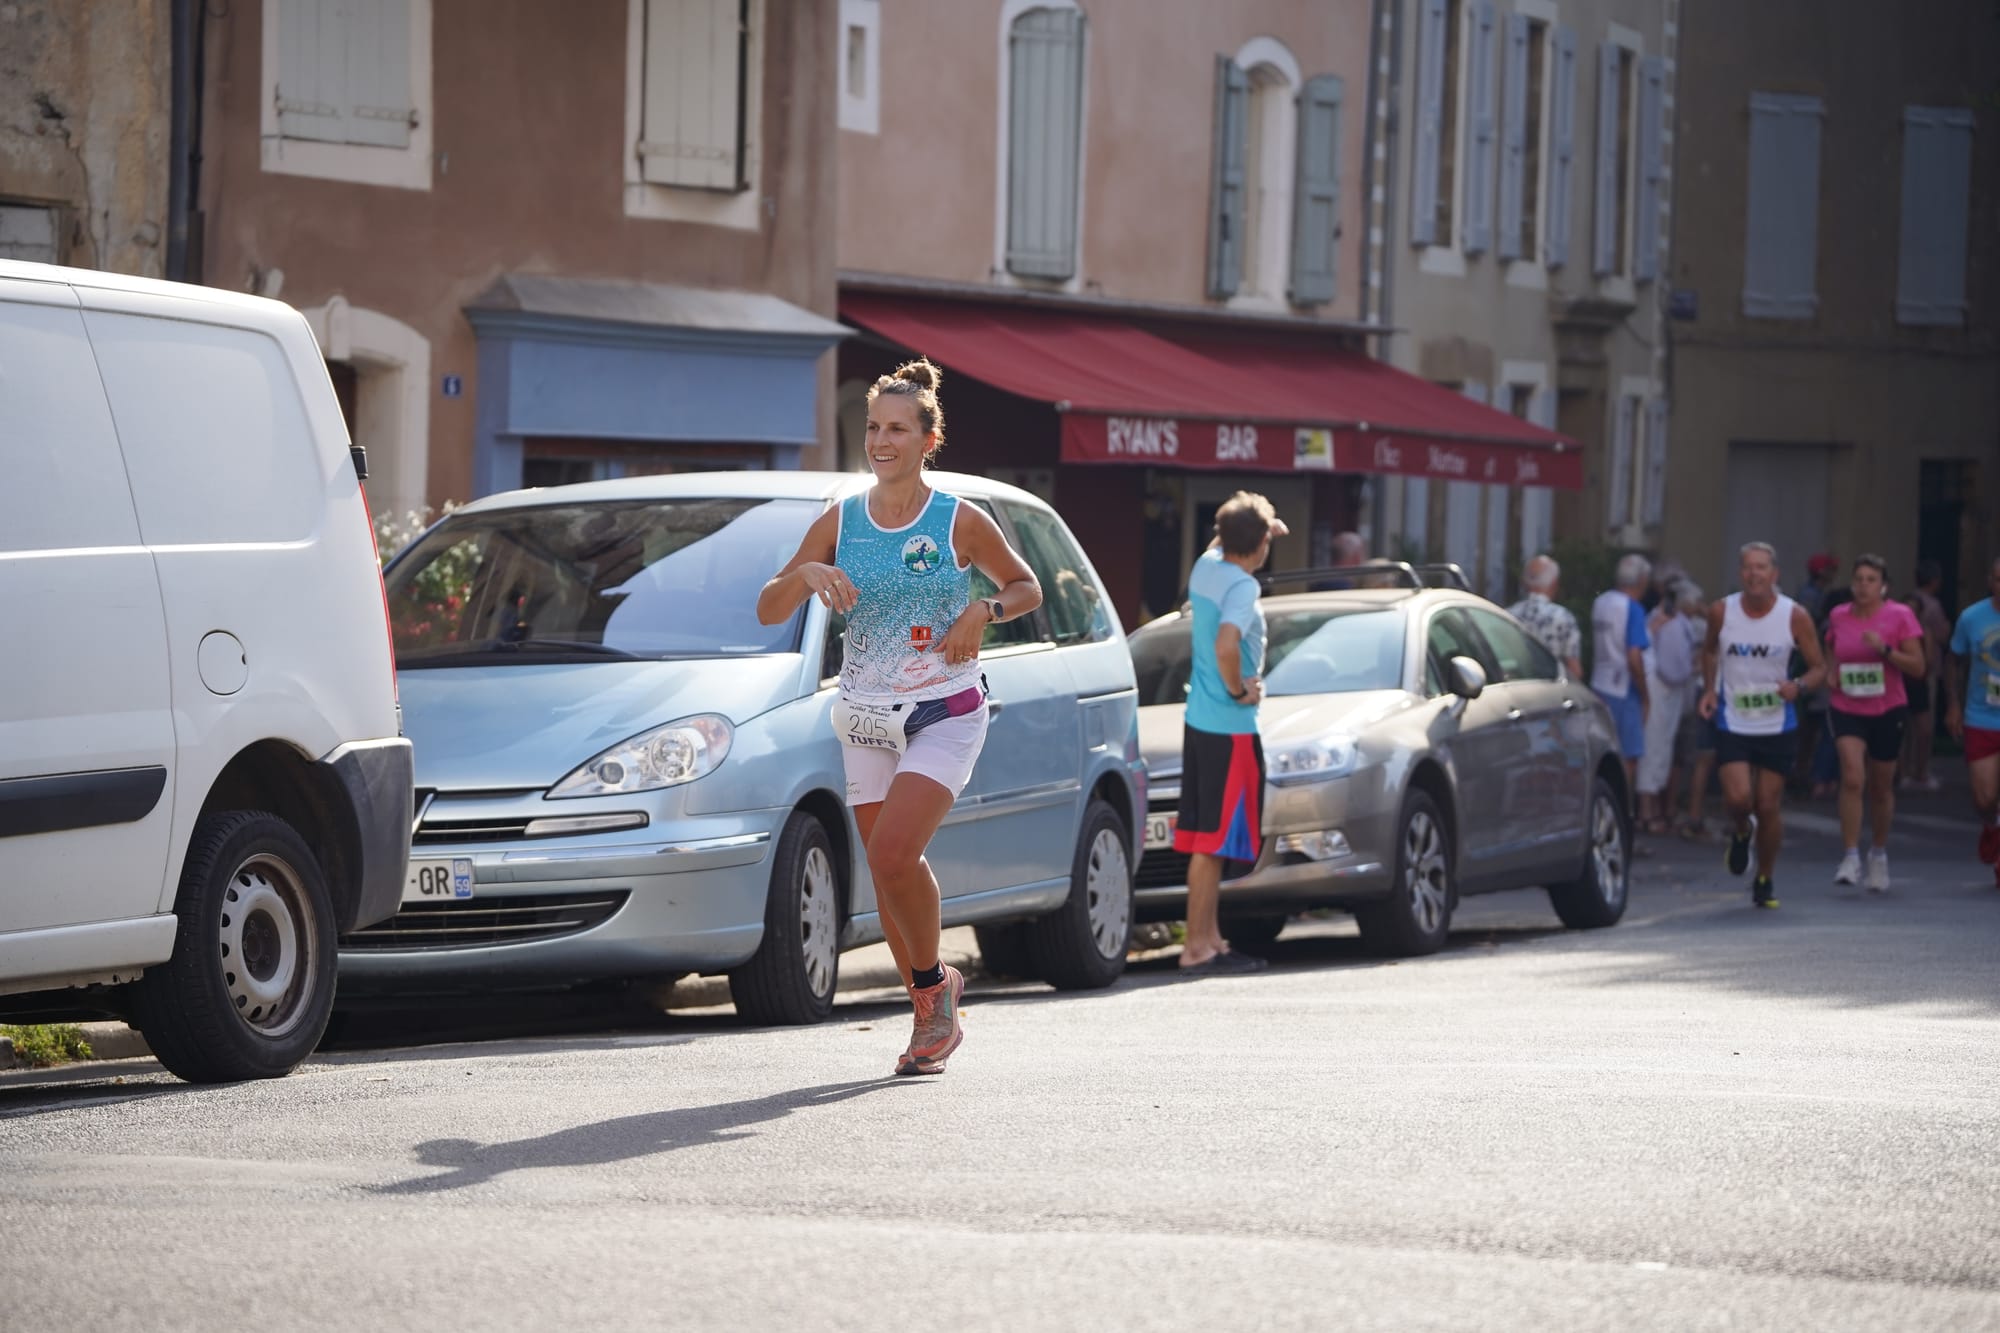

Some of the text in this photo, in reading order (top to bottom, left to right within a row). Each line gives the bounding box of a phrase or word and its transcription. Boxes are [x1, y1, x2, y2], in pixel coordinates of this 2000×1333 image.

[1107, 418, 1258, 459] RYAN'S BAR
[1847, 671, 1877, 685] 155
[1741, 693, 1773, 709] 151
[849, 714, 888, 737] 205
[847, 733, 898, 749] TUFF'S
[455, 878, 470, 893] 59
